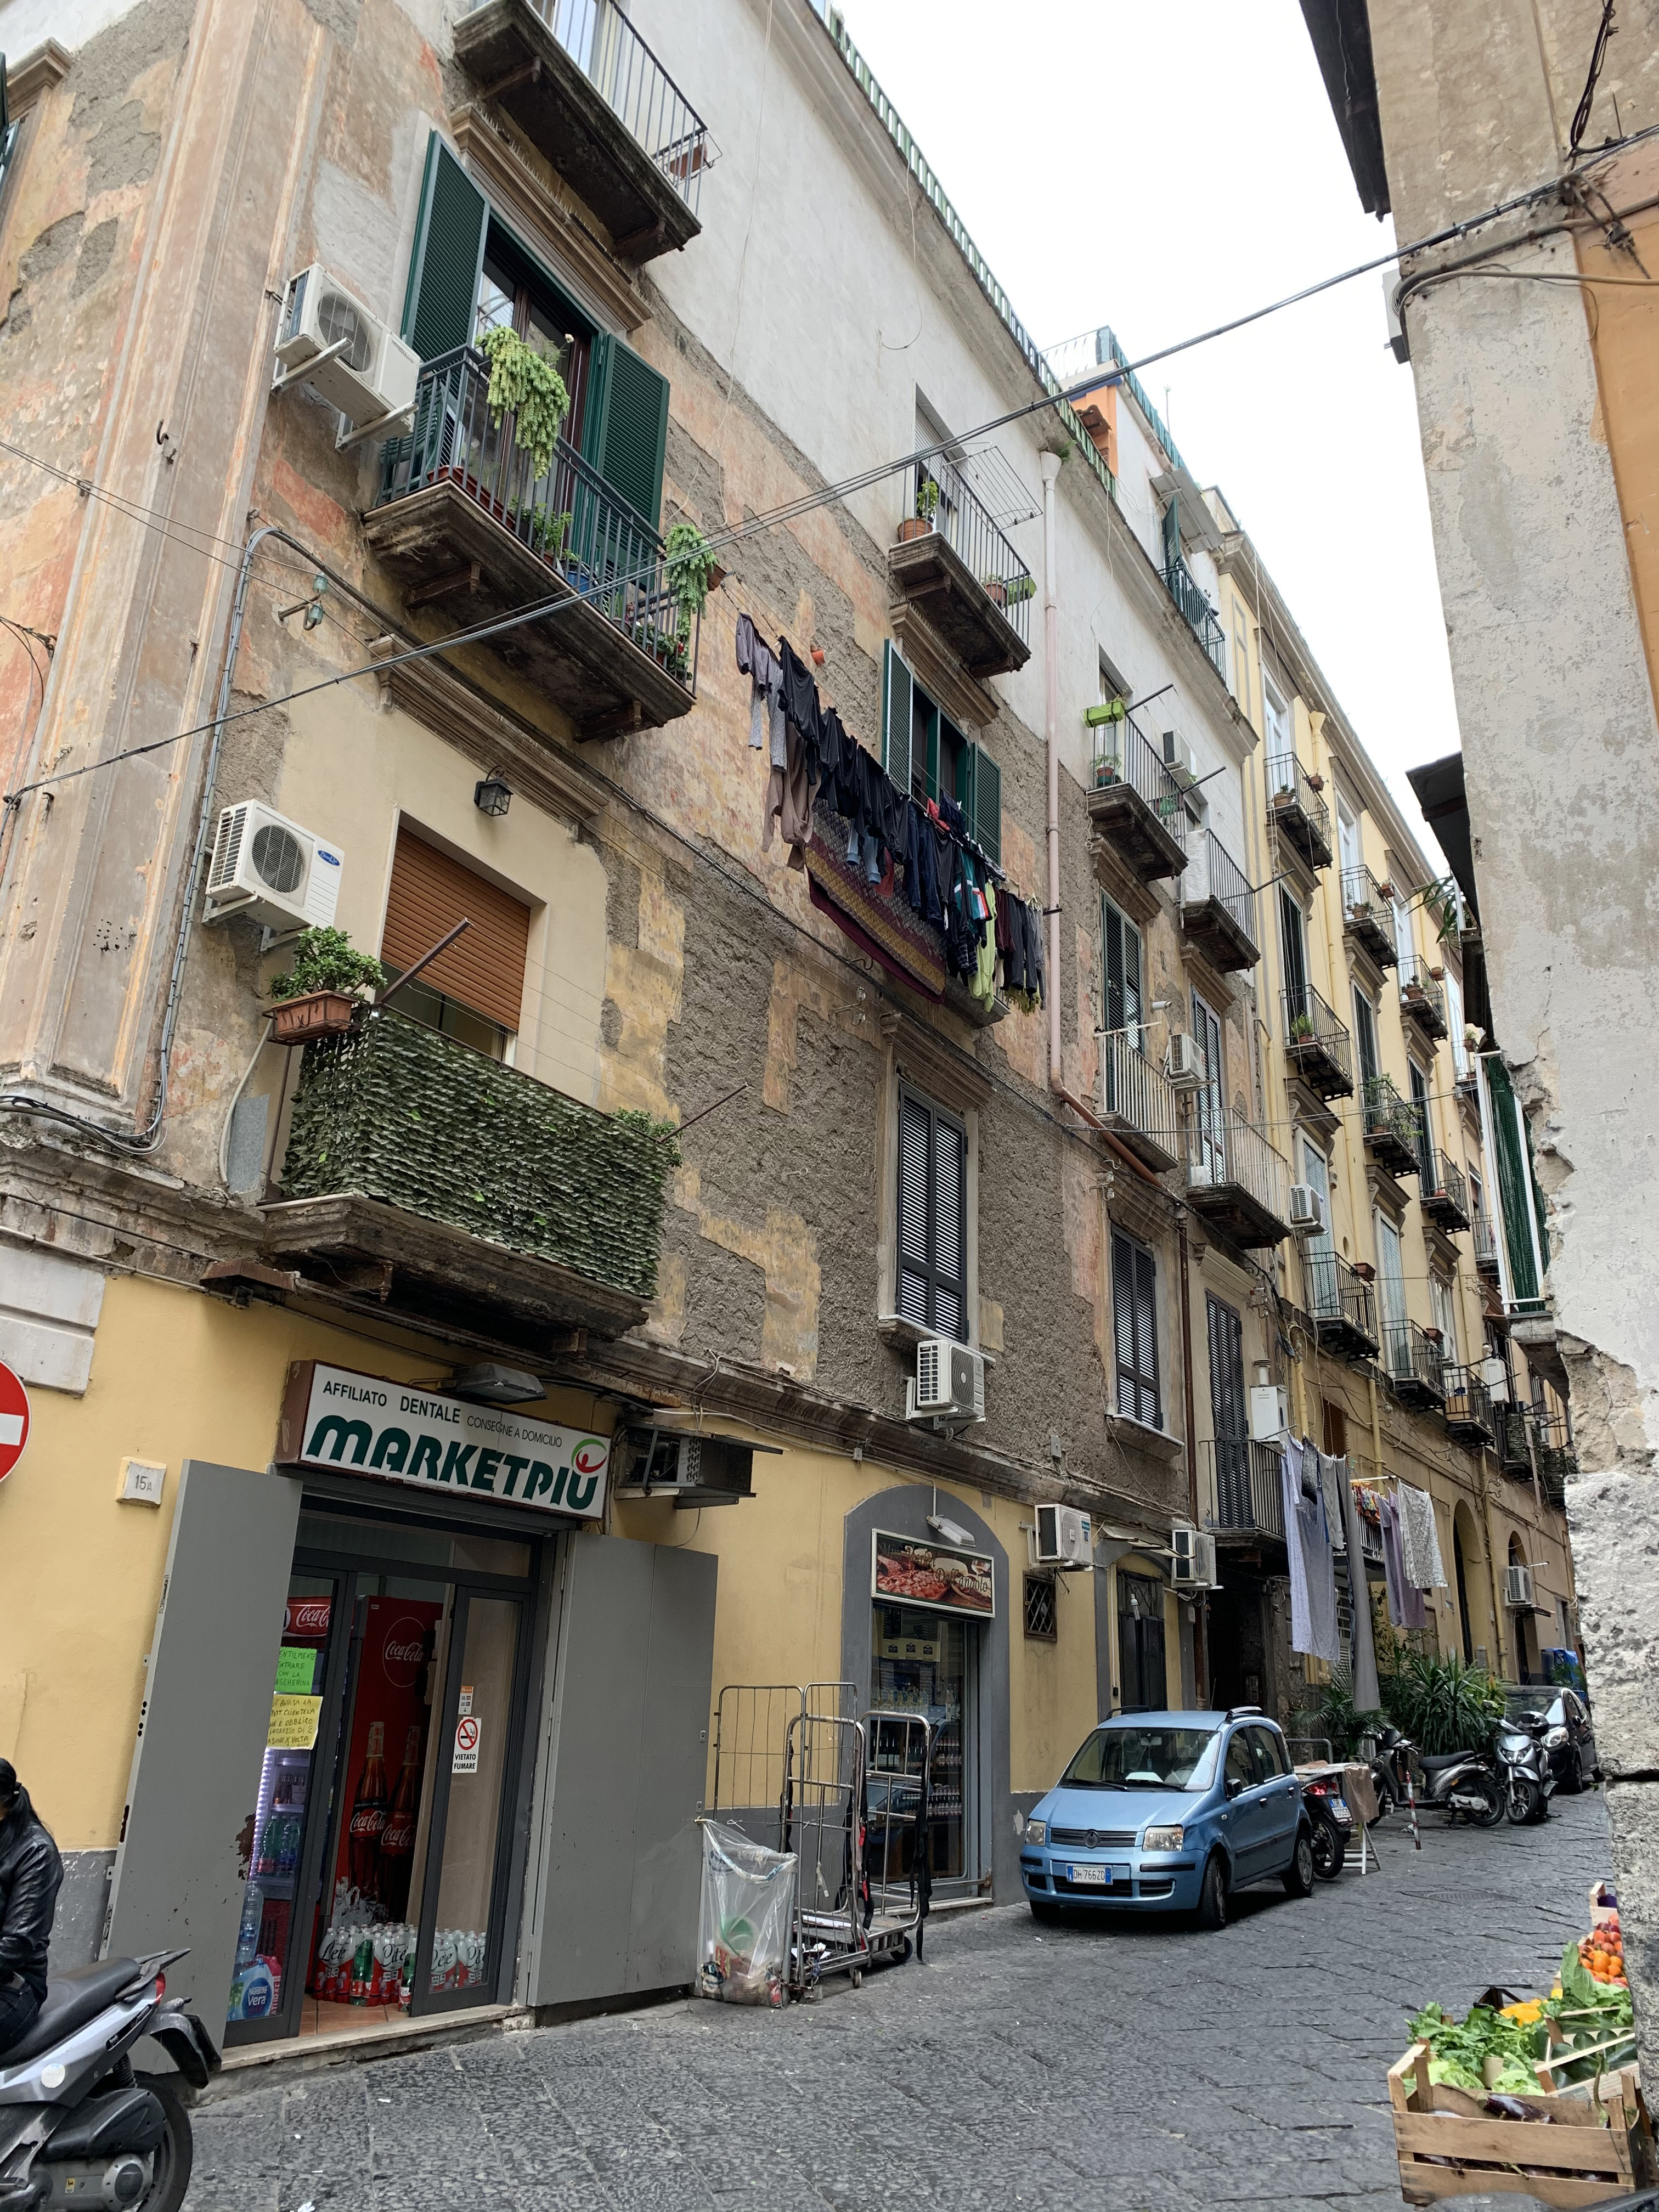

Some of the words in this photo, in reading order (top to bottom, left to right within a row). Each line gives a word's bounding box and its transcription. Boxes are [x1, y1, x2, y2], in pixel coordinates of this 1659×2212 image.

[323, 1380, 388, 1407] AFFILIATO
[399, 1396, 461, 1424] DENTALE
[466, 1415, 513, 1436] CONSEGNE
[514, 1429, 521, 1438] A
[522, 1431, 562, 1448] DOMICILIO
[385, 1640, 424, 1662] Coca-Cola
[454, 1762, 476, 1770] FUMARE
[455, 1753, 476, 1761] VIETATO
[247, 1992, 266, 2007] Vera
